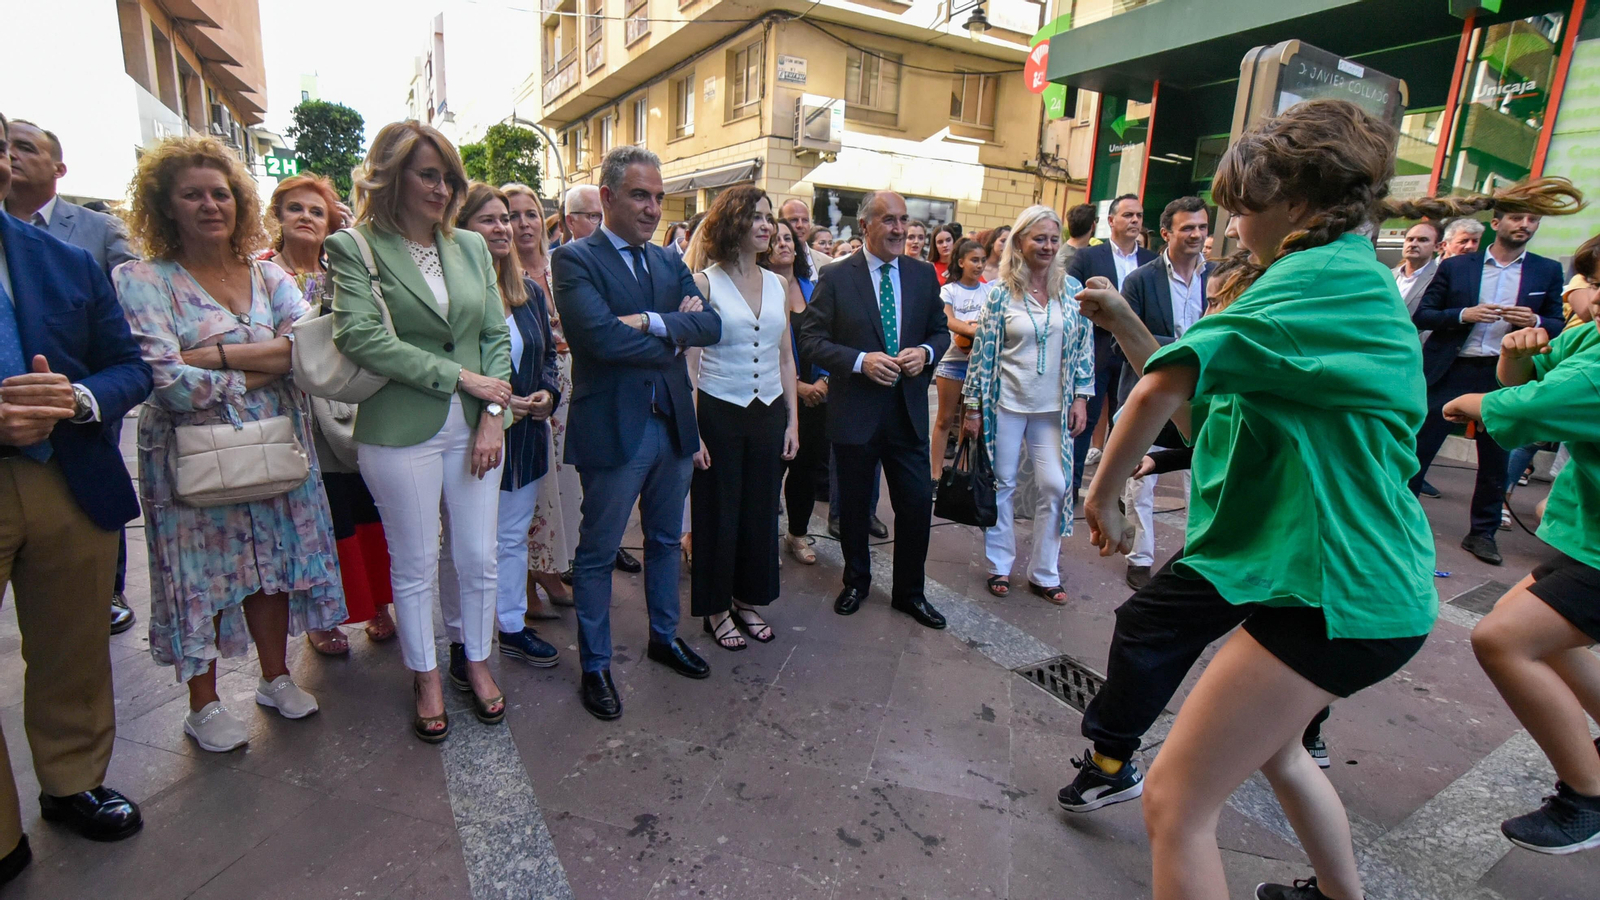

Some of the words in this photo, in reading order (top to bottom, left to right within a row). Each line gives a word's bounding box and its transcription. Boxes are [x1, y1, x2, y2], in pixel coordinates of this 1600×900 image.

[1310, 67, 1344, 87] JAVIER
[1474, 77, 1537, 98] Unicaja
[1050, 97, 1062, 111] 24
